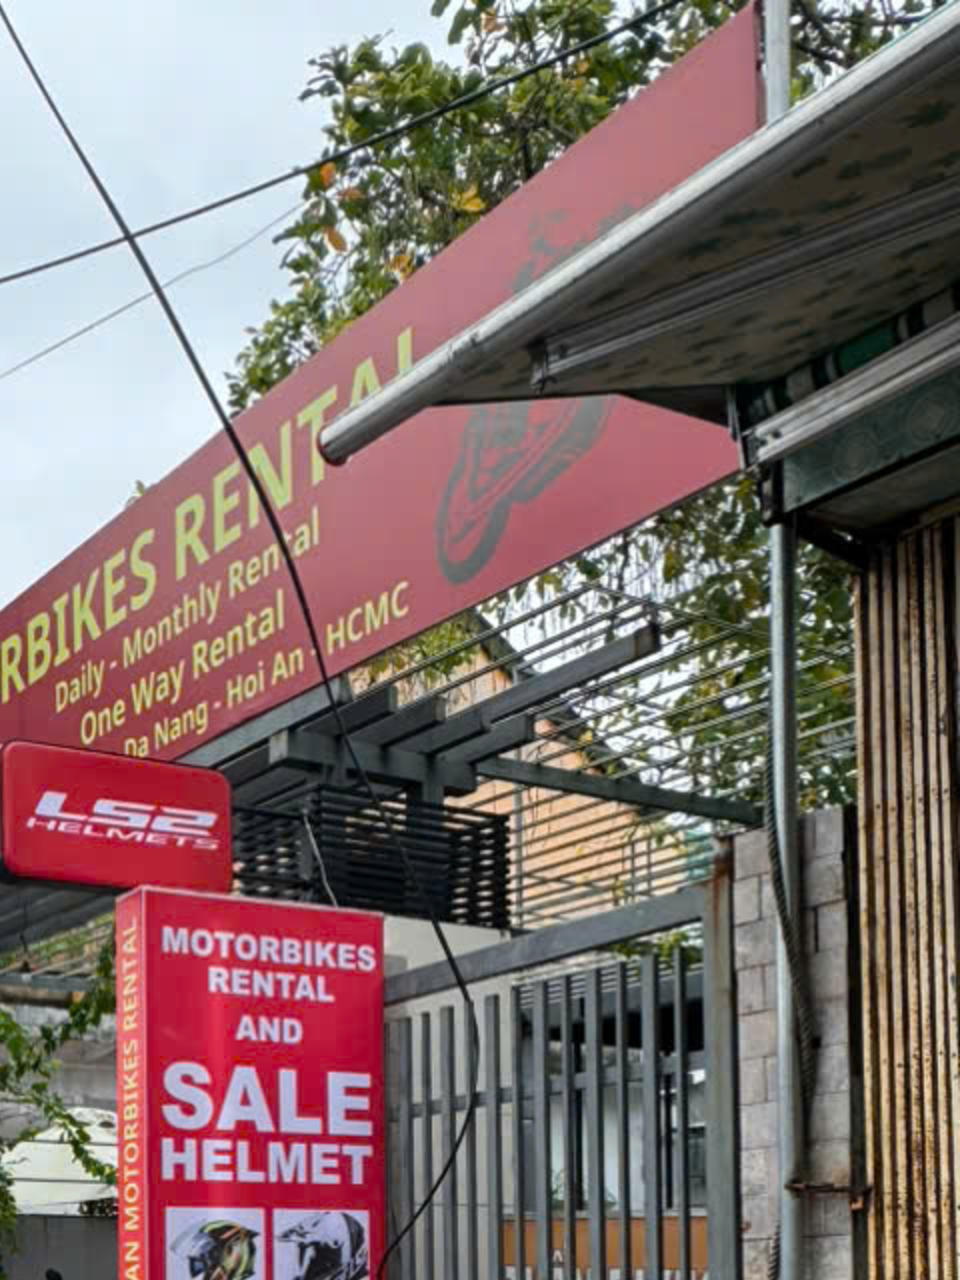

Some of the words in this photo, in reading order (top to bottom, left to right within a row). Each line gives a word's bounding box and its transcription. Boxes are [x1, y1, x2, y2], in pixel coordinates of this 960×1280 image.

[55, 659, 105, 714] Daily
[123, 579, 222, 669] Monthly
[80, 697, 126, 746] One
[130, 660, 186, 716] Way
[192, 588, 285, 679] Rental
[154, 702, 209, 751] Nang
[226, 661, 265, 710] Hoi
[271, 648, 304, 685] An
[326, 581, 410, 655] HCMC
[26, 816, 220, 851] HELMETS
[35, 790, 218, 837] LS2
[122, 917, 138, 1032] RENTAL
[160, 925, 377, 972] MOTORBIKES
[207, 965, 335, 1003] RENTAL
[235, 1014, 303, 1045] AND
[161, 1060, 374, 1137] SALE
[123, 1038, 140, 1231] MOTORBIKES
[160, 1137, 374, 1185] HELMET
